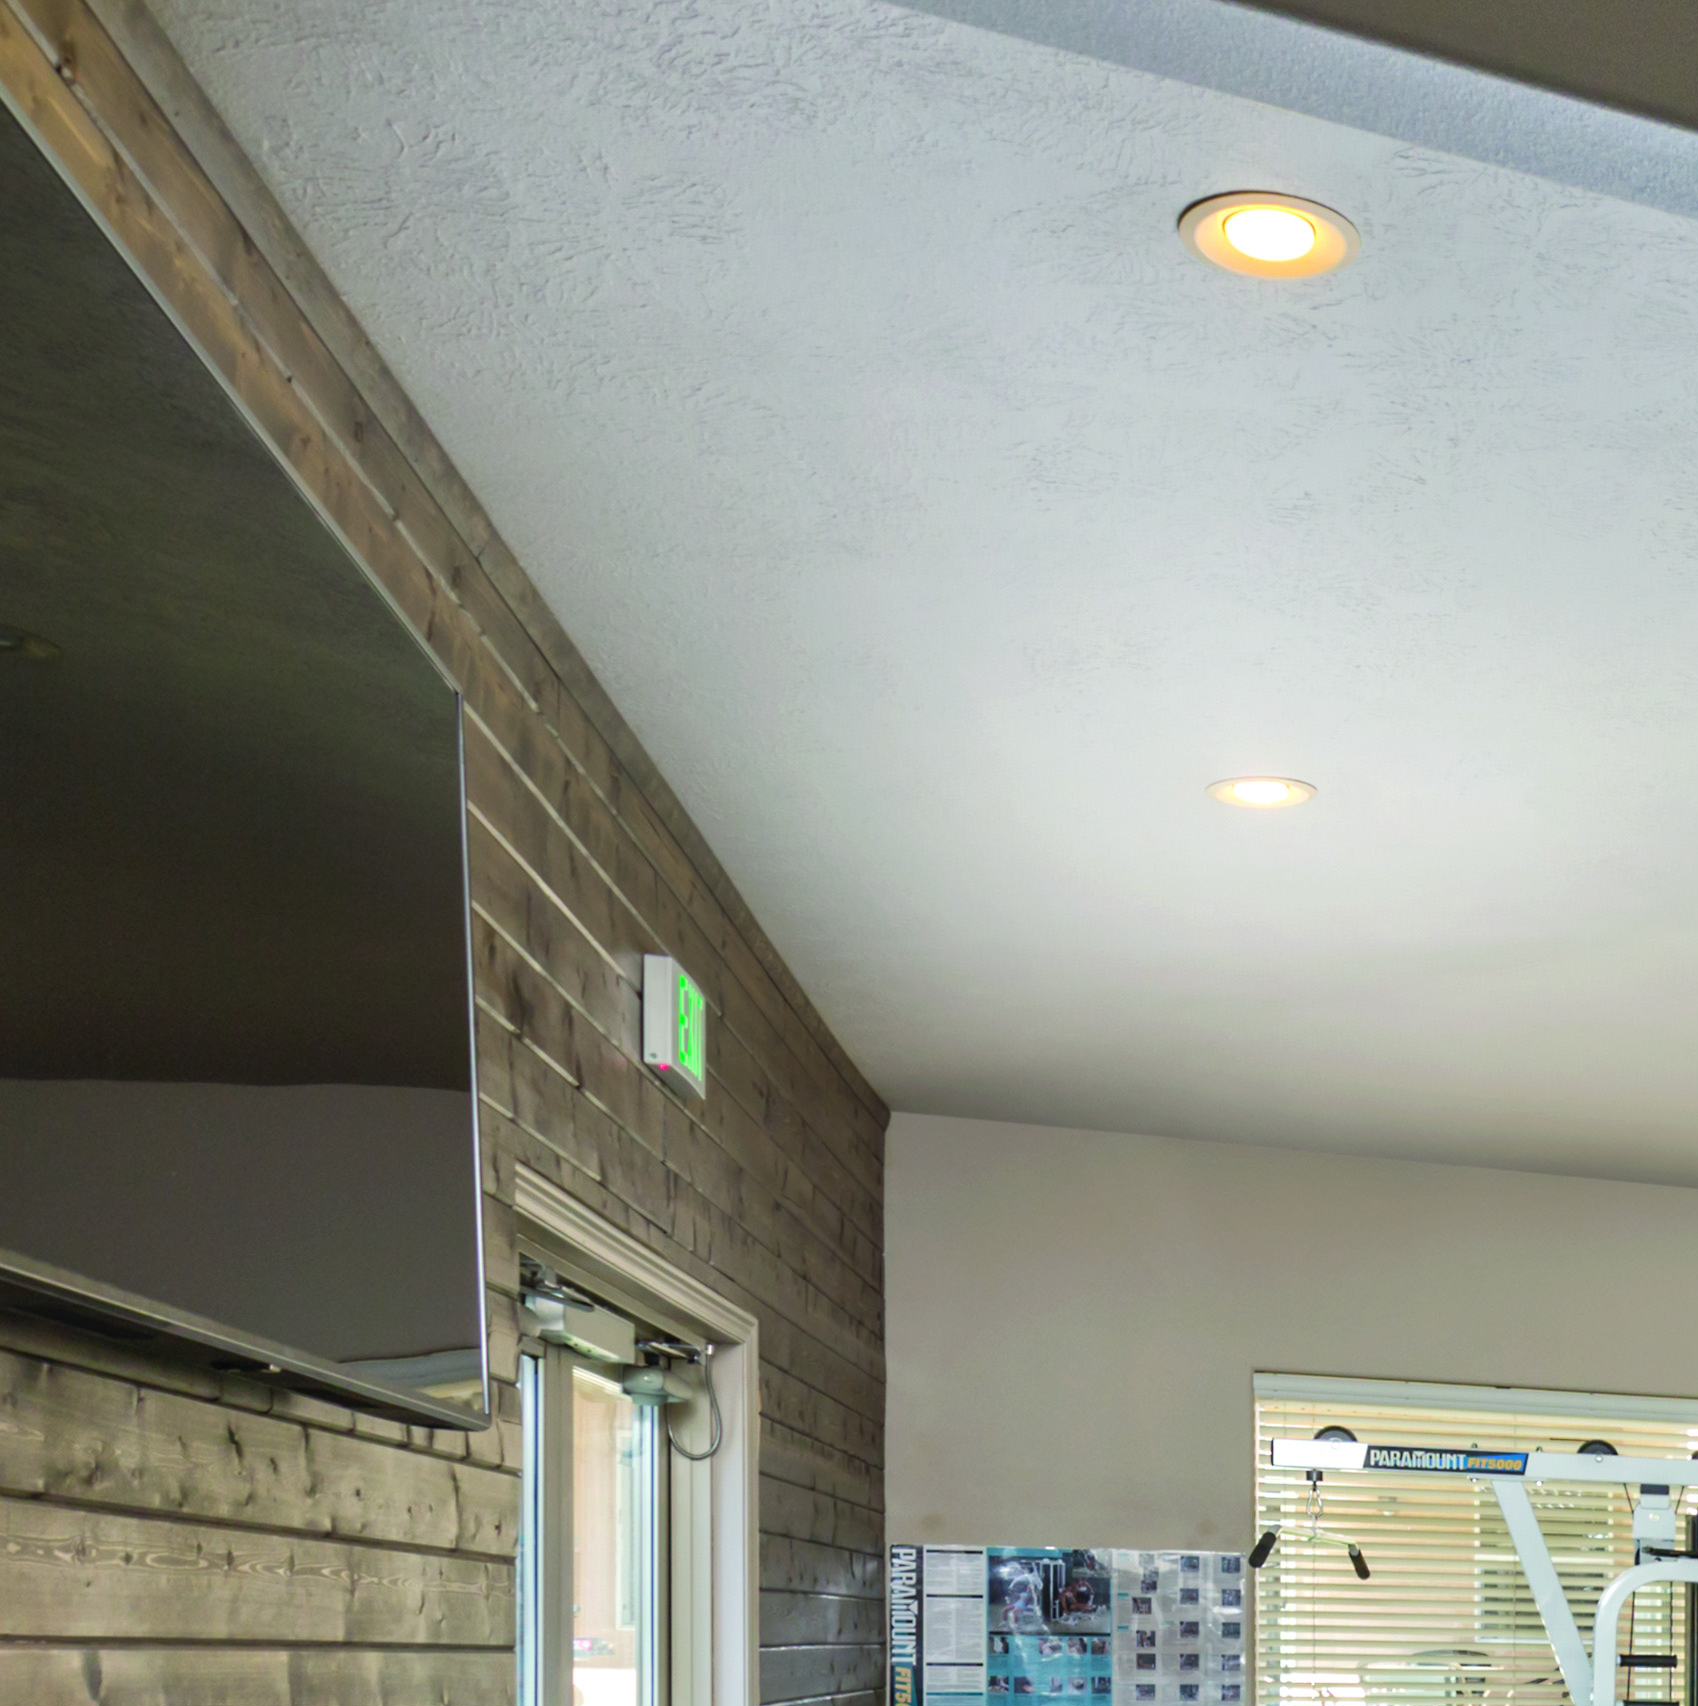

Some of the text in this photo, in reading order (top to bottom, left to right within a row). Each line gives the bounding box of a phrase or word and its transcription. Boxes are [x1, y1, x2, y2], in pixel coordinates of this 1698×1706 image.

[1369, 1449, 1523, 1471] PARAMOUNT FIT5000
[891, 1547, 918, 1665] PARAMOUNT
